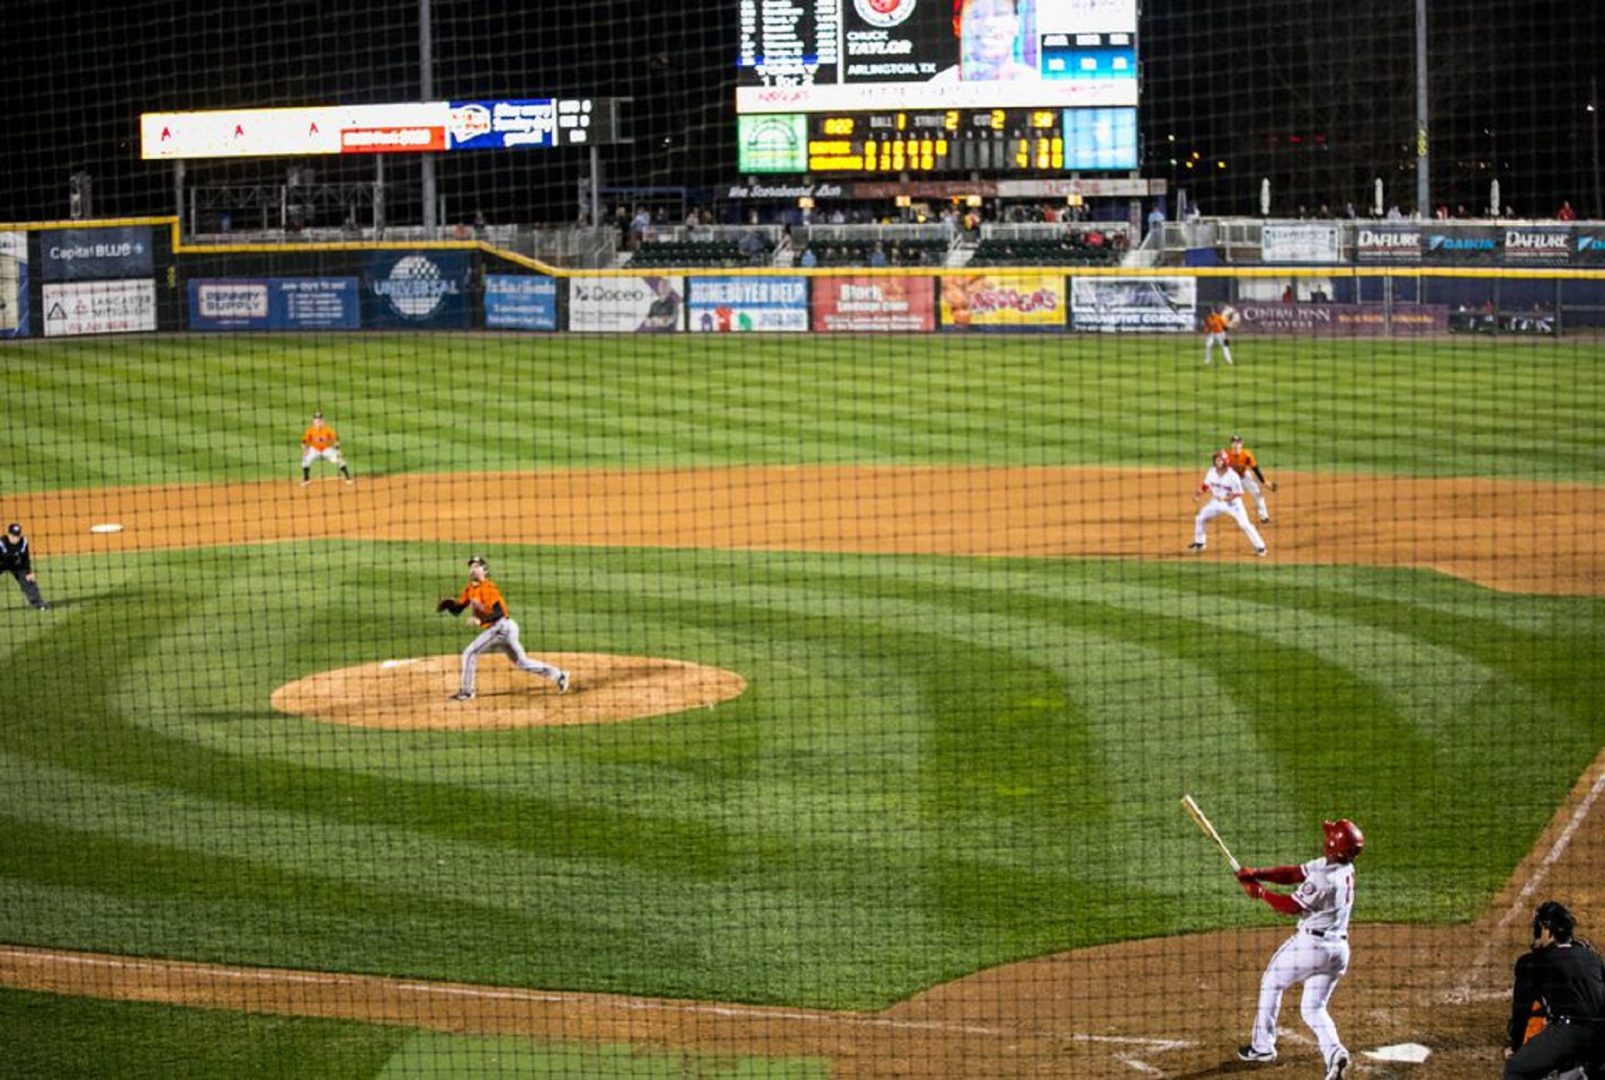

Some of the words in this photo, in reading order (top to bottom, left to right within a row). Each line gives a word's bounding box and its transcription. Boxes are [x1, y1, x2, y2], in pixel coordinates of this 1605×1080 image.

[847, 31, 889, 41] CHUCK
[848, 40, 912, 55] TAYLOR
[946, 110, 959, 130] 2
[991, 110, 1005, 129] 2
[750, 185, 814, 197] Scoreboard
[1444, 239, 1496, 250] DAIKIN
[50, 246, 94, 261] Capital
[374, 279, 459, 296] UNIVERSAL
[592, 285, 645, 302] Doceo
[691, 283, 769, 303] HOMEBUYER
[771, 283, 804, 303] HELP
[91, 296, 152, 306] LANCASTER
[206, 301, 260, 311] SUPPLY
[971, 288, 1057, 312] AROOGA'S
[1244, 307, 1293, 321] CENTRAL
